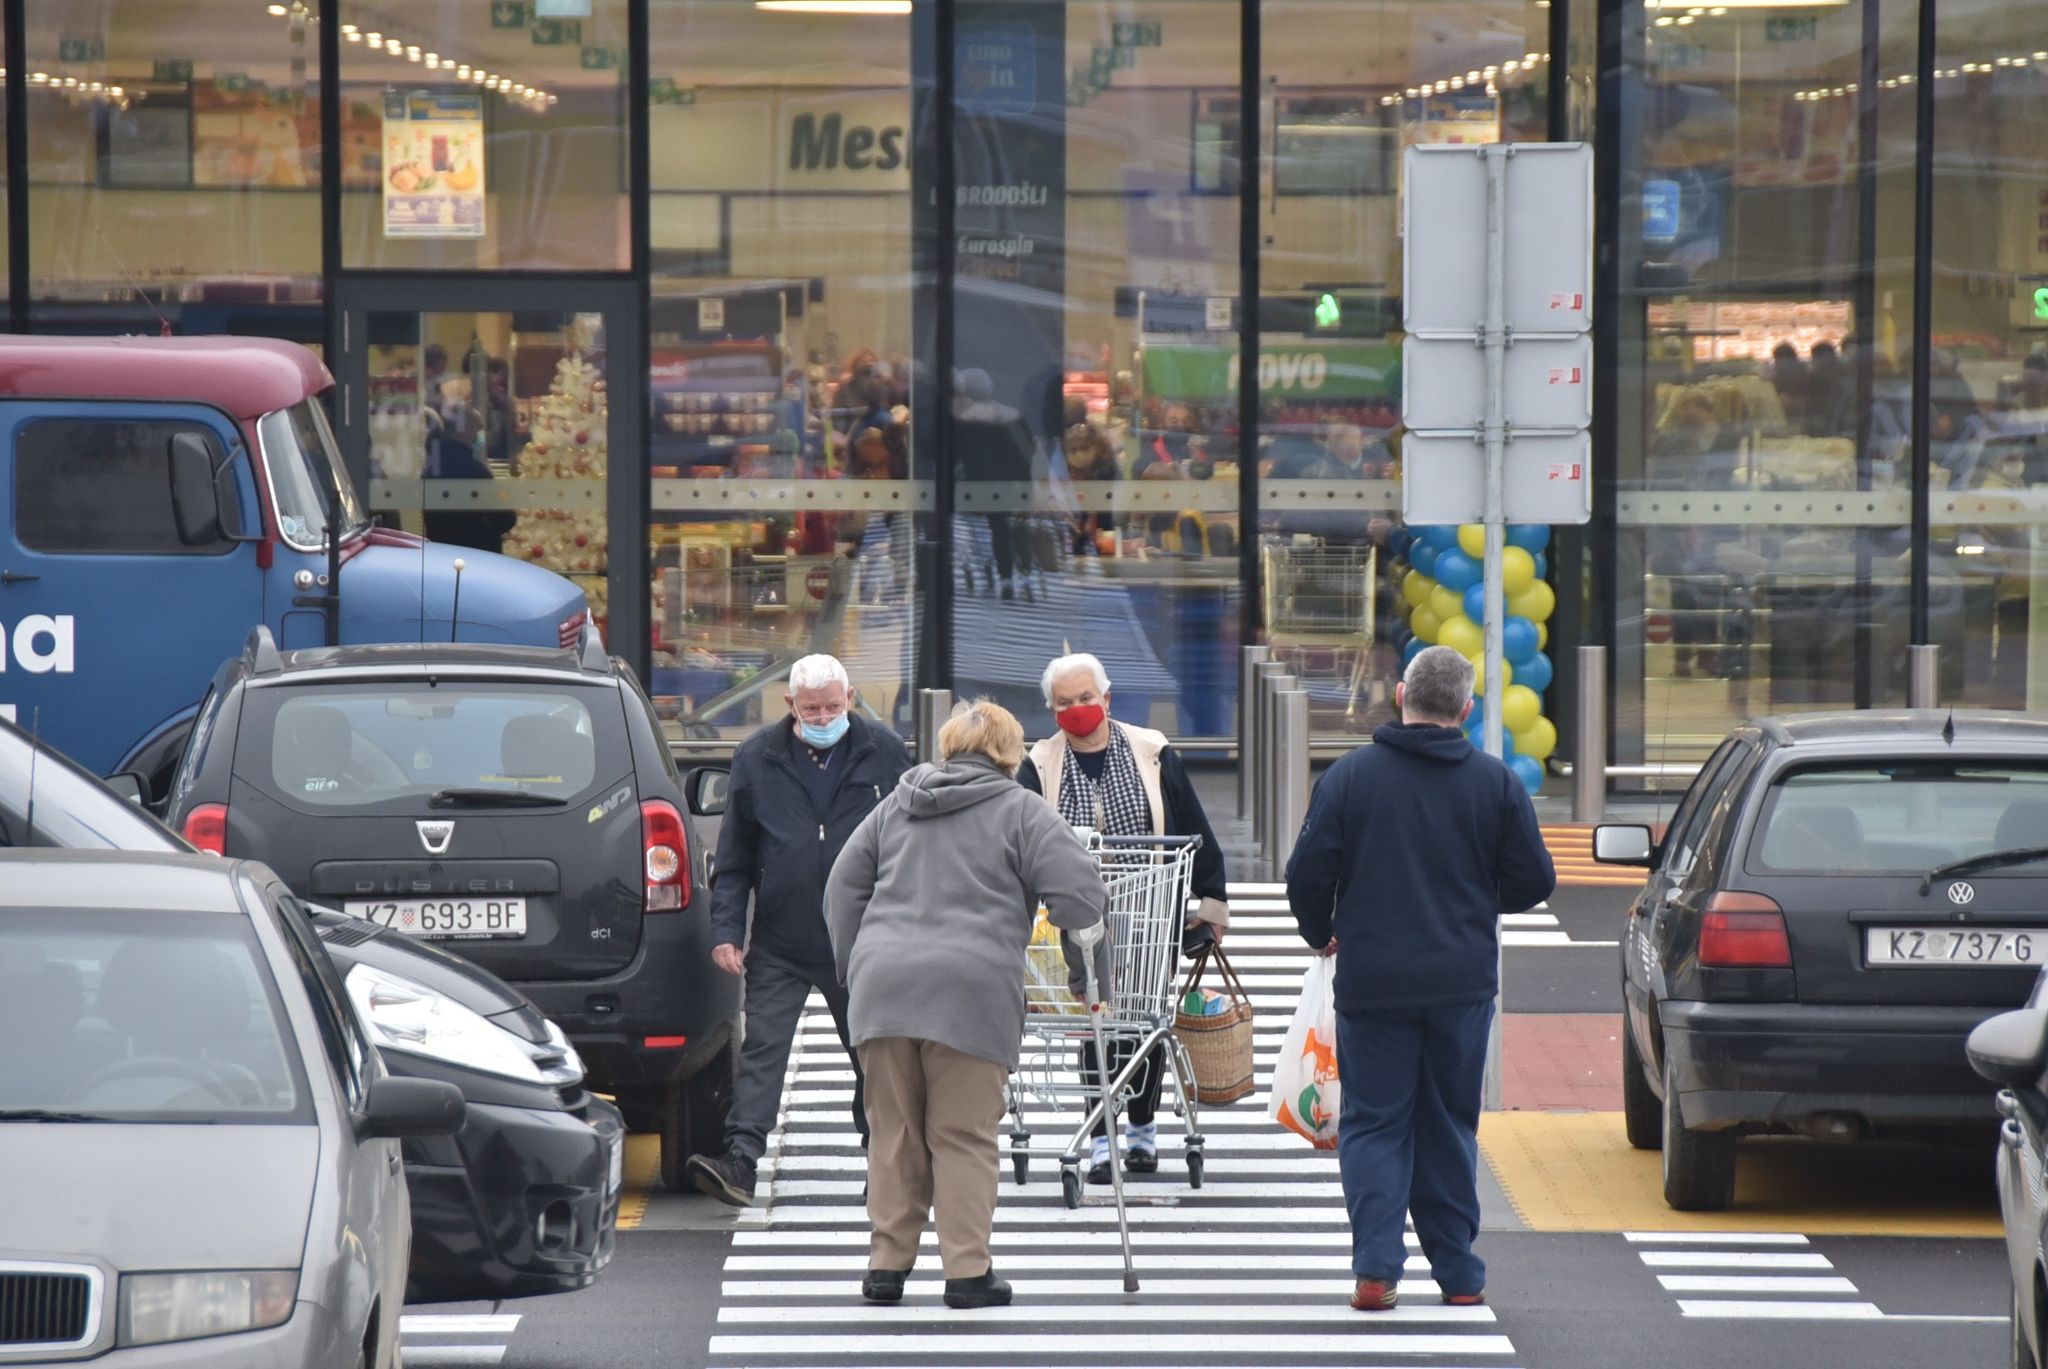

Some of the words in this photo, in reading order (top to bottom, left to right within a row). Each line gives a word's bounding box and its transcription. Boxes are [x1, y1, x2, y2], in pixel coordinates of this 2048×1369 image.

[789, 112, 911, 171] Mes
[958, 235, 1034, 258] Eurospin
[305, 781, 327, 791] elf
[588, 786, 631, 823] 4WD
[421, 902, 518, 930] 693-BF
